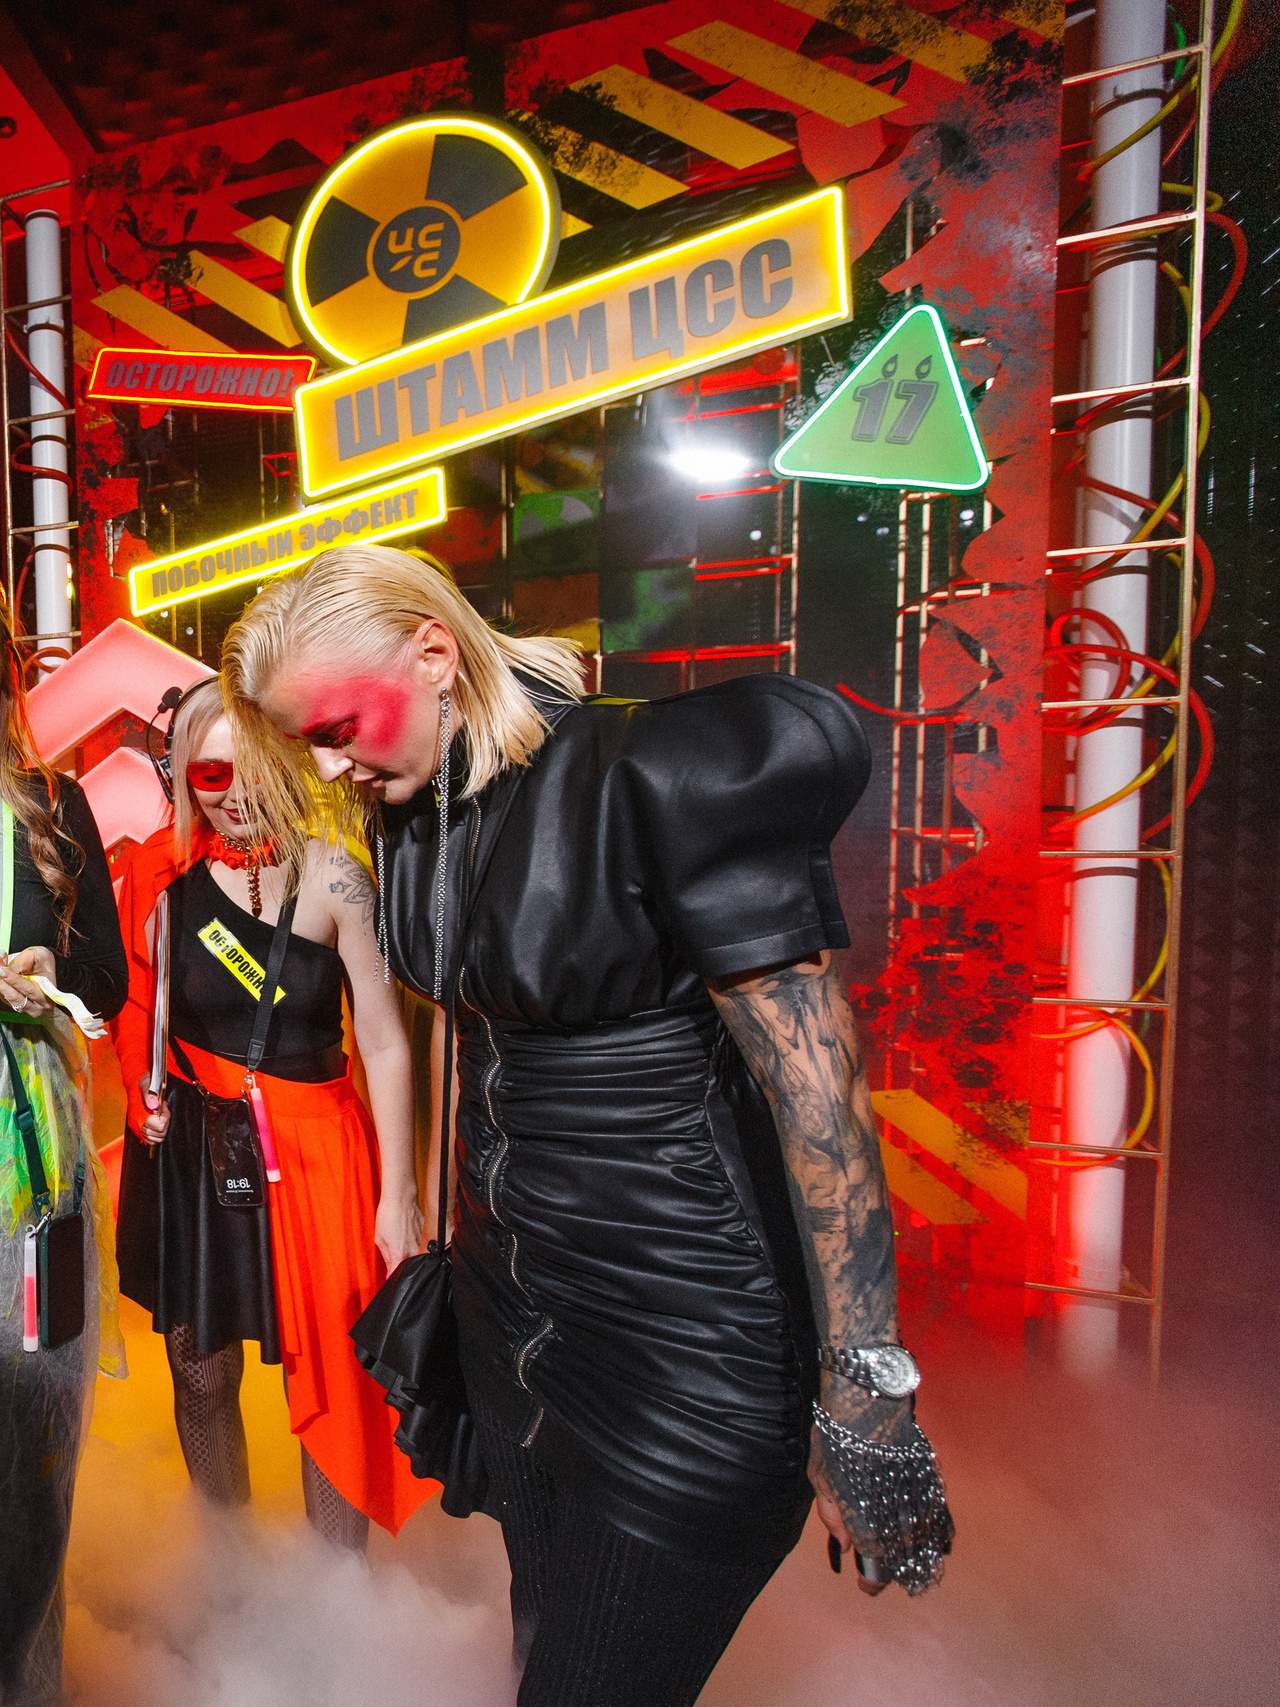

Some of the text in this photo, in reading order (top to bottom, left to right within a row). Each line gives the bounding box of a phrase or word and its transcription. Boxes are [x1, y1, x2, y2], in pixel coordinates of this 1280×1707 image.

[106, 360, 295, 398] ОСТОРОЖНО!
[334, 237, 794, 461] ШТАММ ЦСС
[851, 378, 939, 445] 17
[298, 489, 419, 551] ЭФФЕКТ
[208, 929, 265, 991] ОСТОРОЖН
[226, 1177, 251, 1189] 19:18
